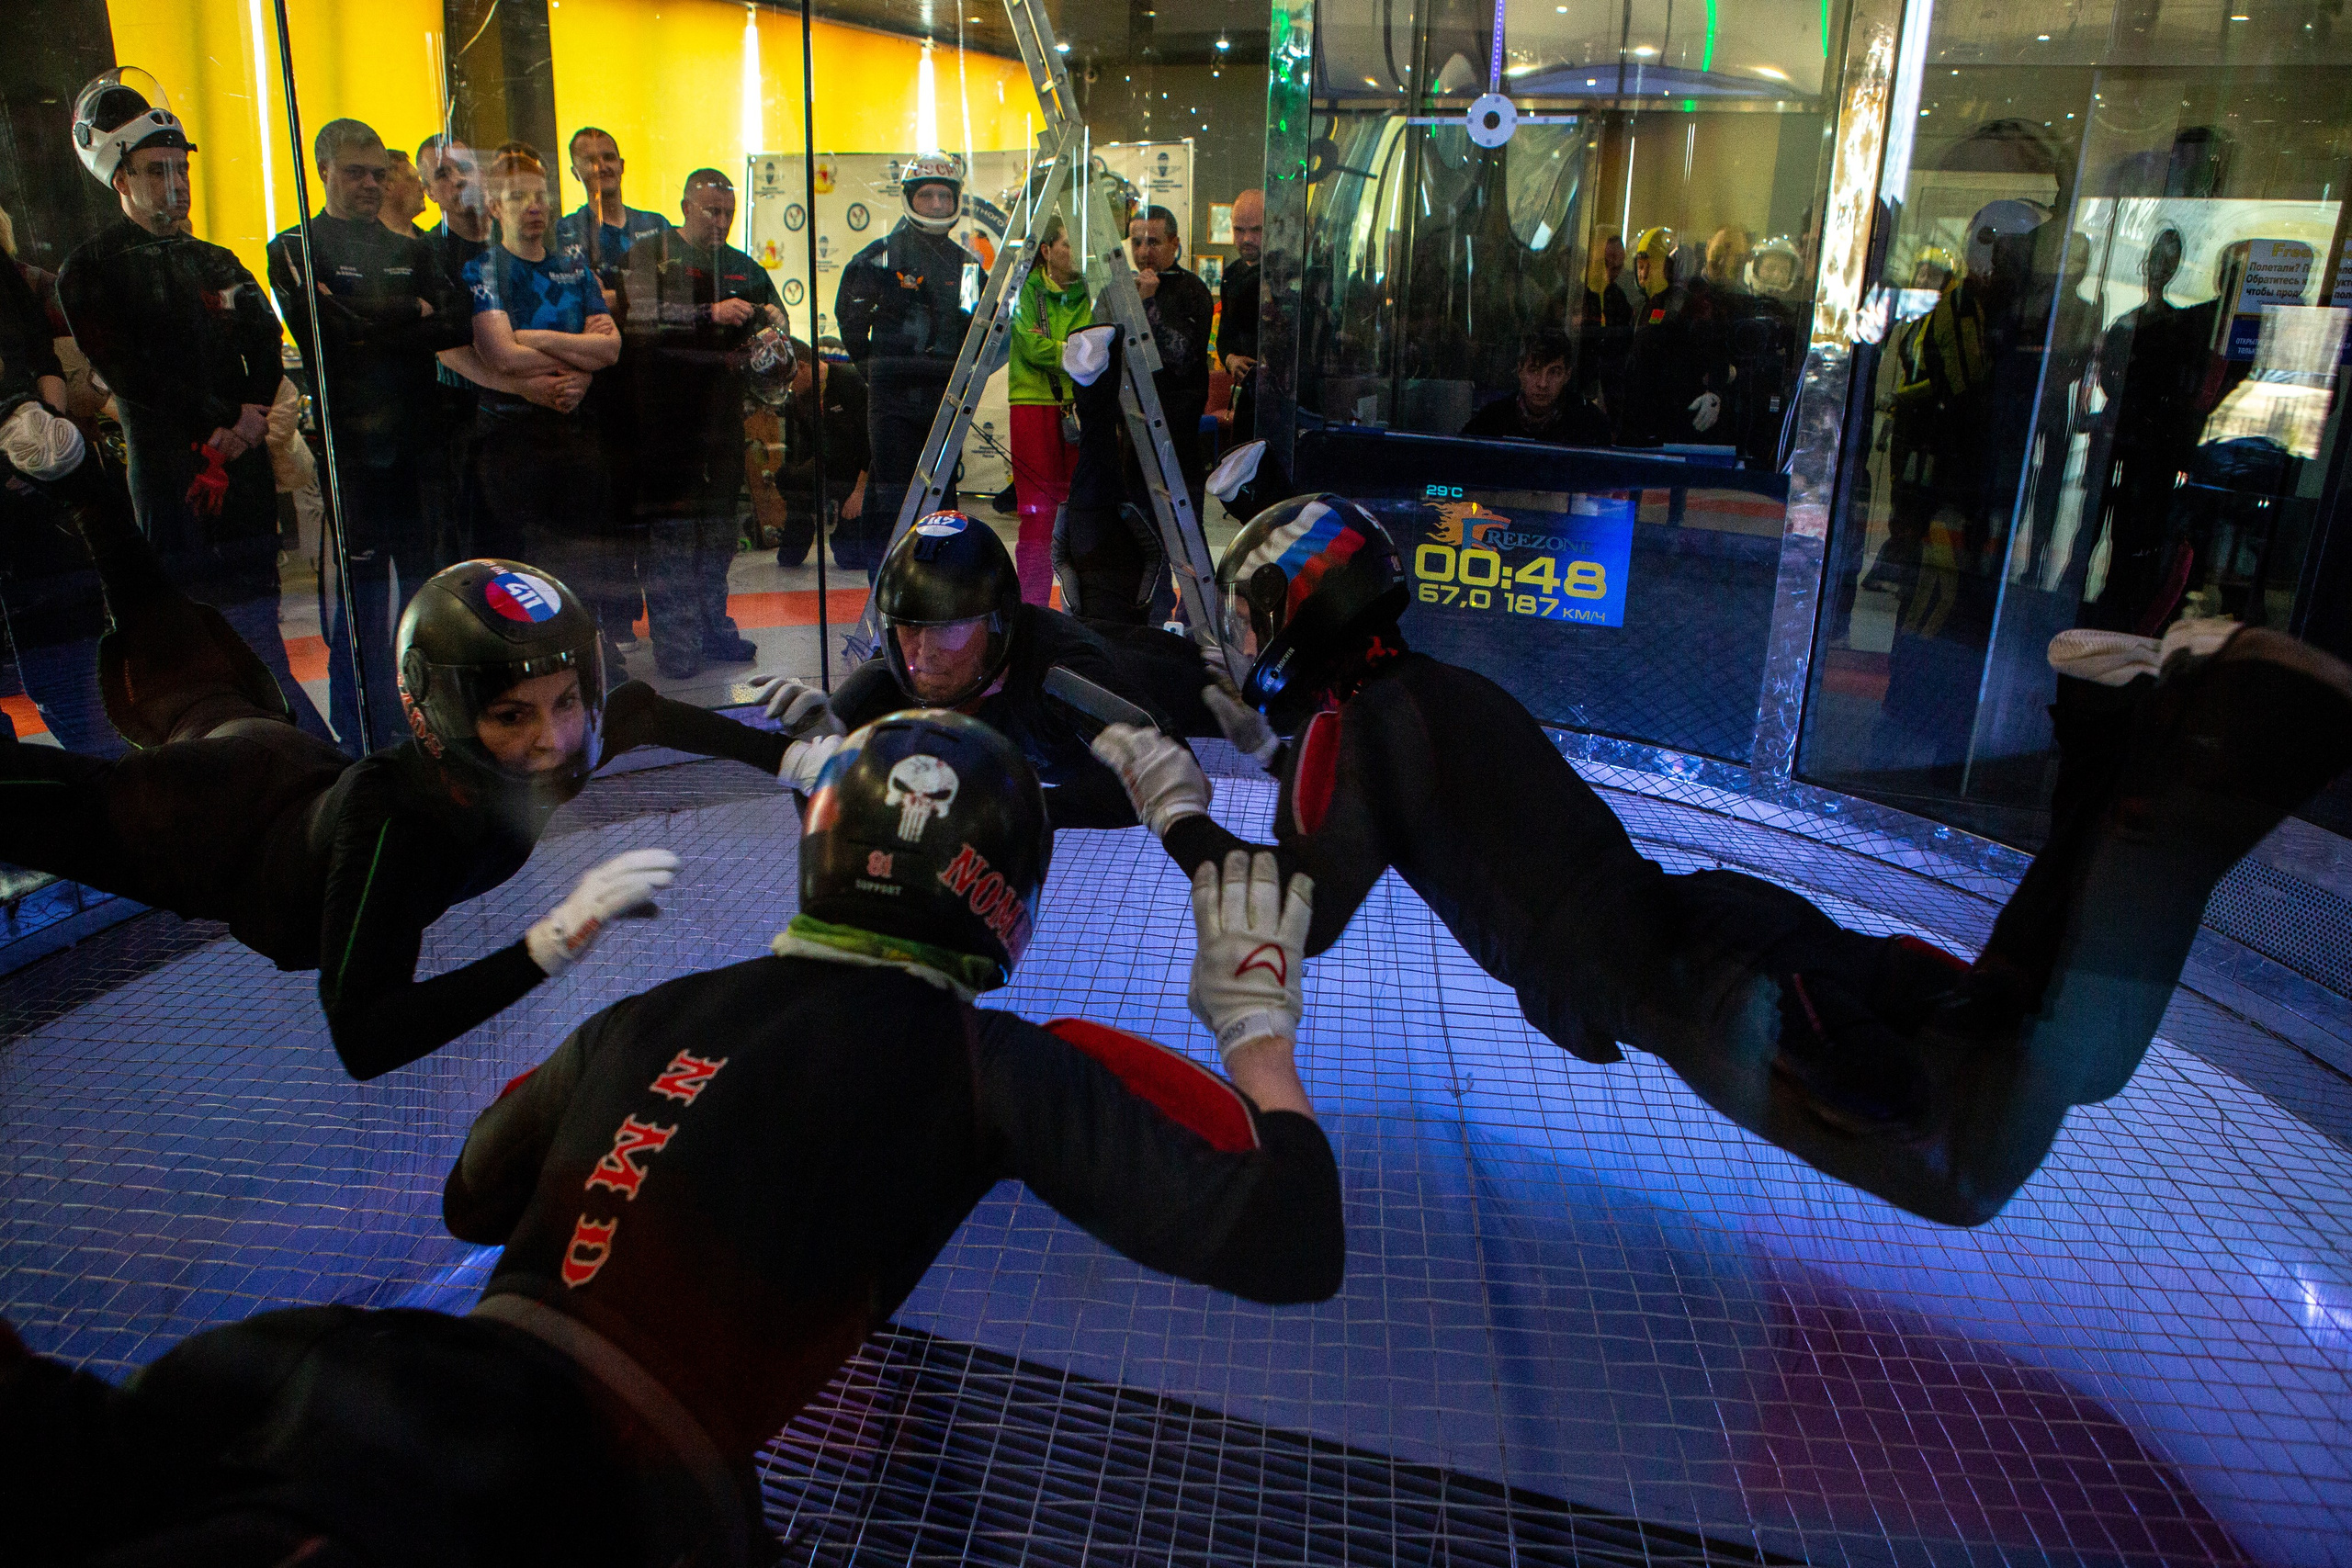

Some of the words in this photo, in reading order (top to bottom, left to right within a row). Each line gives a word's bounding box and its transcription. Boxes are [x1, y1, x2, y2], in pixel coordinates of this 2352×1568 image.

[2246, 274, 2300, 286] Обратитесь
[2246, 287, 2274, 298] чтобы
[1415, 543, 1608, 601] 00:48
[1419, 583, 1491, 610] 67,0
[1504, 592, 1559, 617] 187
[936, 841, 1027, 948] NOM
